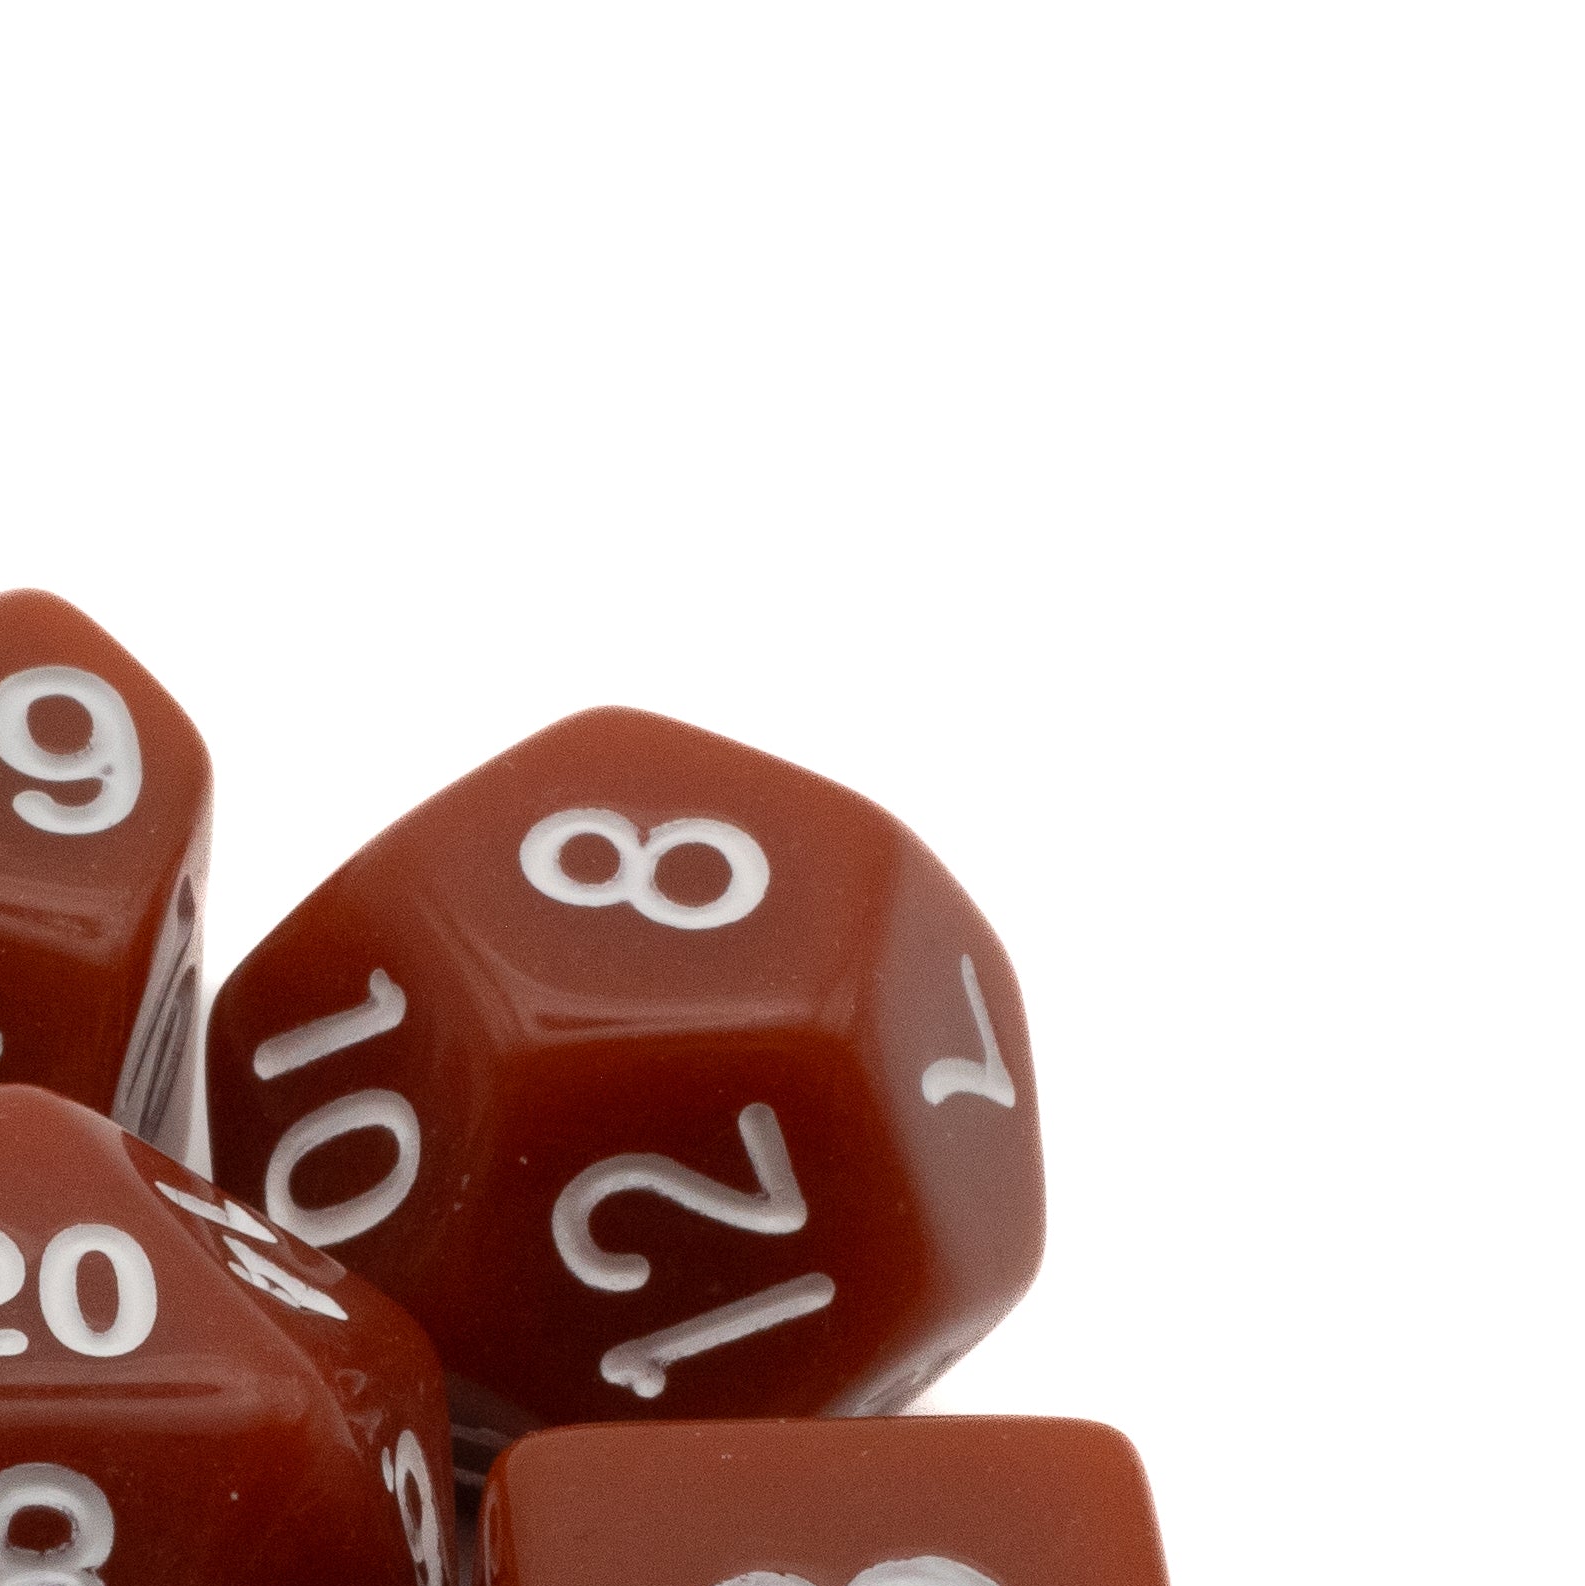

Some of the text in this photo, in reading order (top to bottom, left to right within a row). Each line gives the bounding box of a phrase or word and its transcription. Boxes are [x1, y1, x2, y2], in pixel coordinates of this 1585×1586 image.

[518, 808, 770, 930] 8
[252, 967, 420, 1250] 10
[552, 1102, 836, 1398] 12
